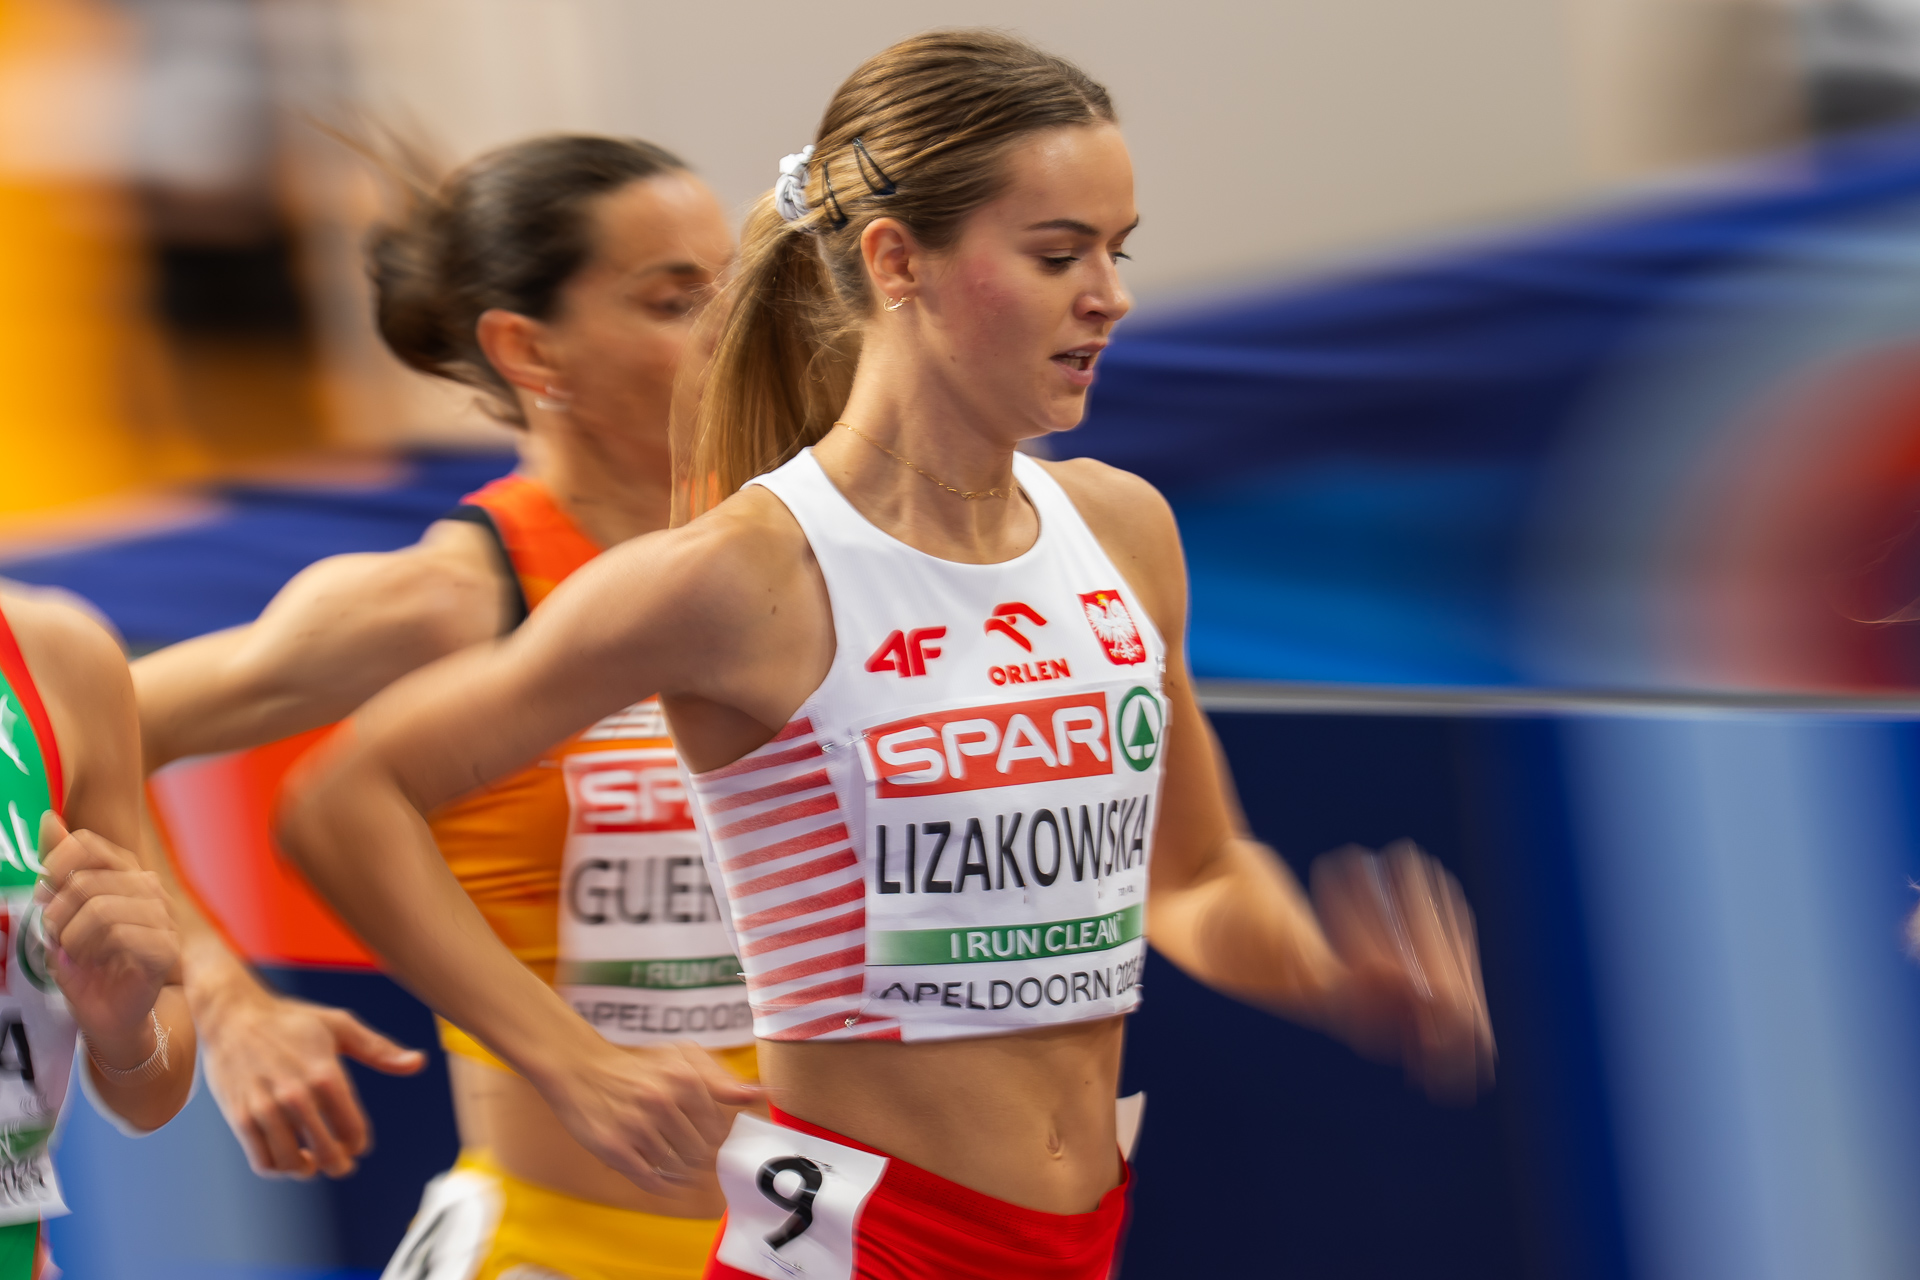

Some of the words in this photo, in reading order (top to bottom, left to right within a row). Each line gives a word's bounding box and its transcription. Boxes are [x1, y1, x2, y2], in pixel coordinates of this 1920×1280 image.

[864, 625, 947, 678] 4F
[988, 658, 1071, 686] ORLEN
[876, 705, 1108, 786] SPAR
[875, 794, 1149, 895] LIZAKOWSKA
[949, 932, 960, 959] I
[967, 927, 1039, 959] RUN
[878, 967, 1111, 1011] APELDOORN
[755, 1155, 822, 1251] 9
